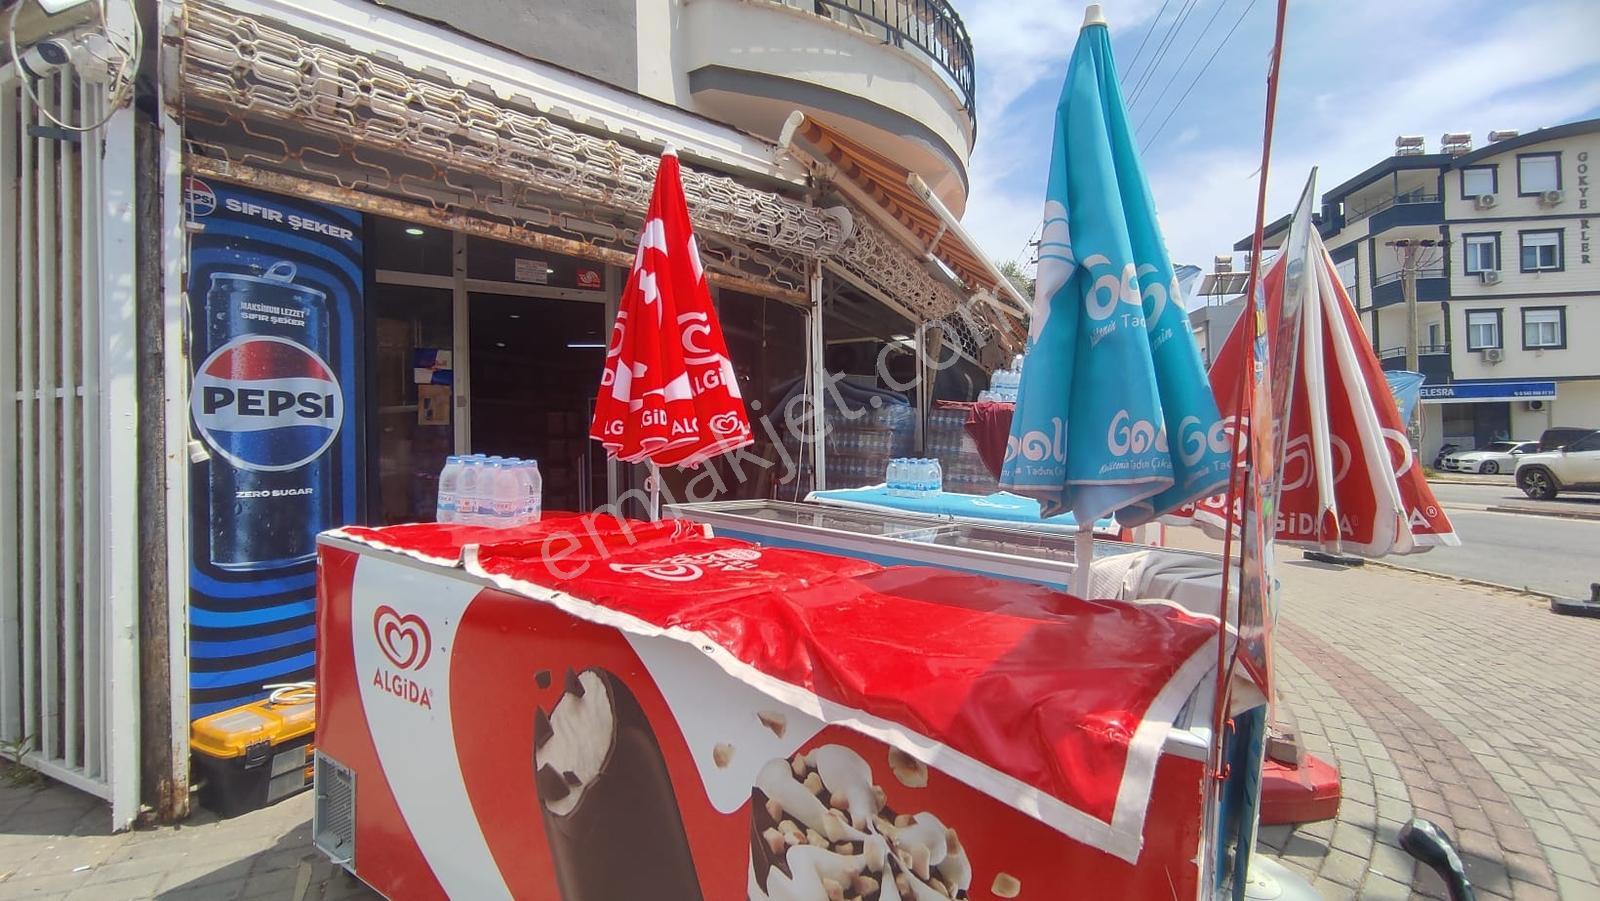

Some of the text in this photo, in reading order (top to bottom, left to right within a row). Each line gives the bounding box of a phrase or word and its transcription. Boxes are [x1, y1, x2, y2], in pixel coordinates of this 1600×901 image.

[225, 198, 354, 242] SIFIR ŞEKER
[280, 307, 305, 319] LEZZET
[203, 386, 334, 419] PEPSI
[236, 487, 314, 498] ZERO SUGAR
